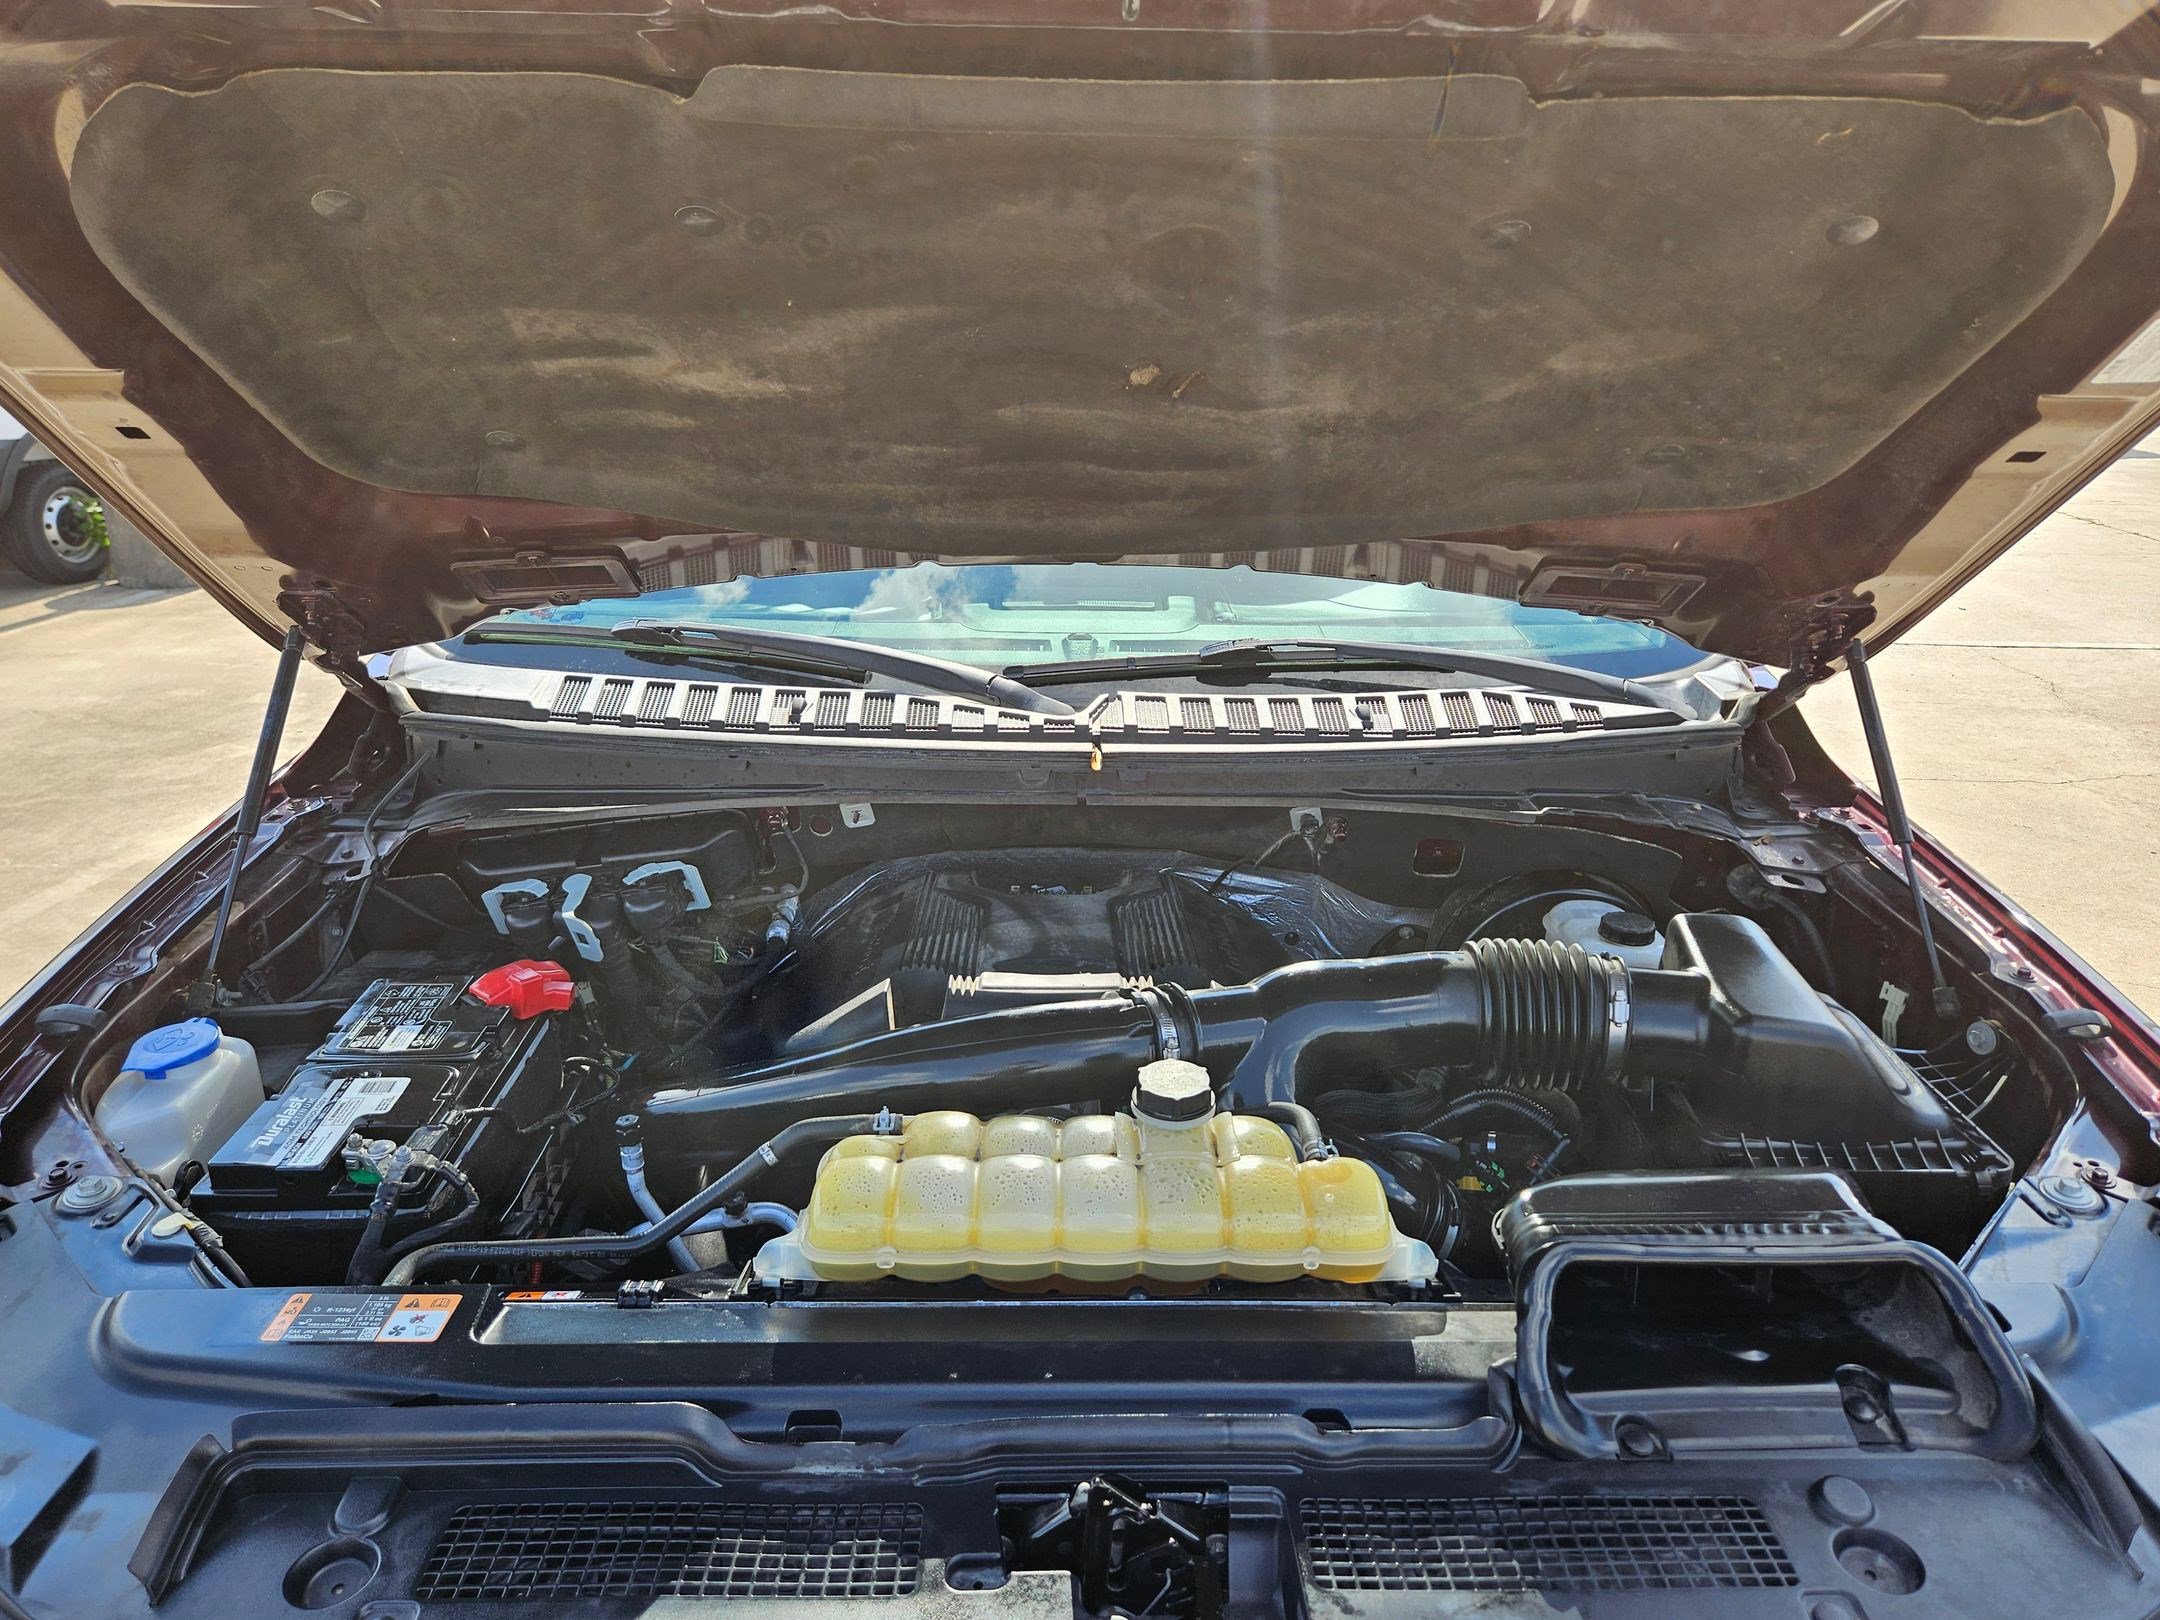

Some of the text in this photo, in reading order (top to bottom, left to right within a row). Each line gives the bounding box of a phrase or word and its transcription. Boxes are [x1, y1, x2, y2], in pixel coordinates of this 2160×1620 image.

[251, 1096, 307, 1148] Duralast
[284, 1097, 318, 1133] PLATINUM
[326, 1306, 356, 1314] R-1234yf
